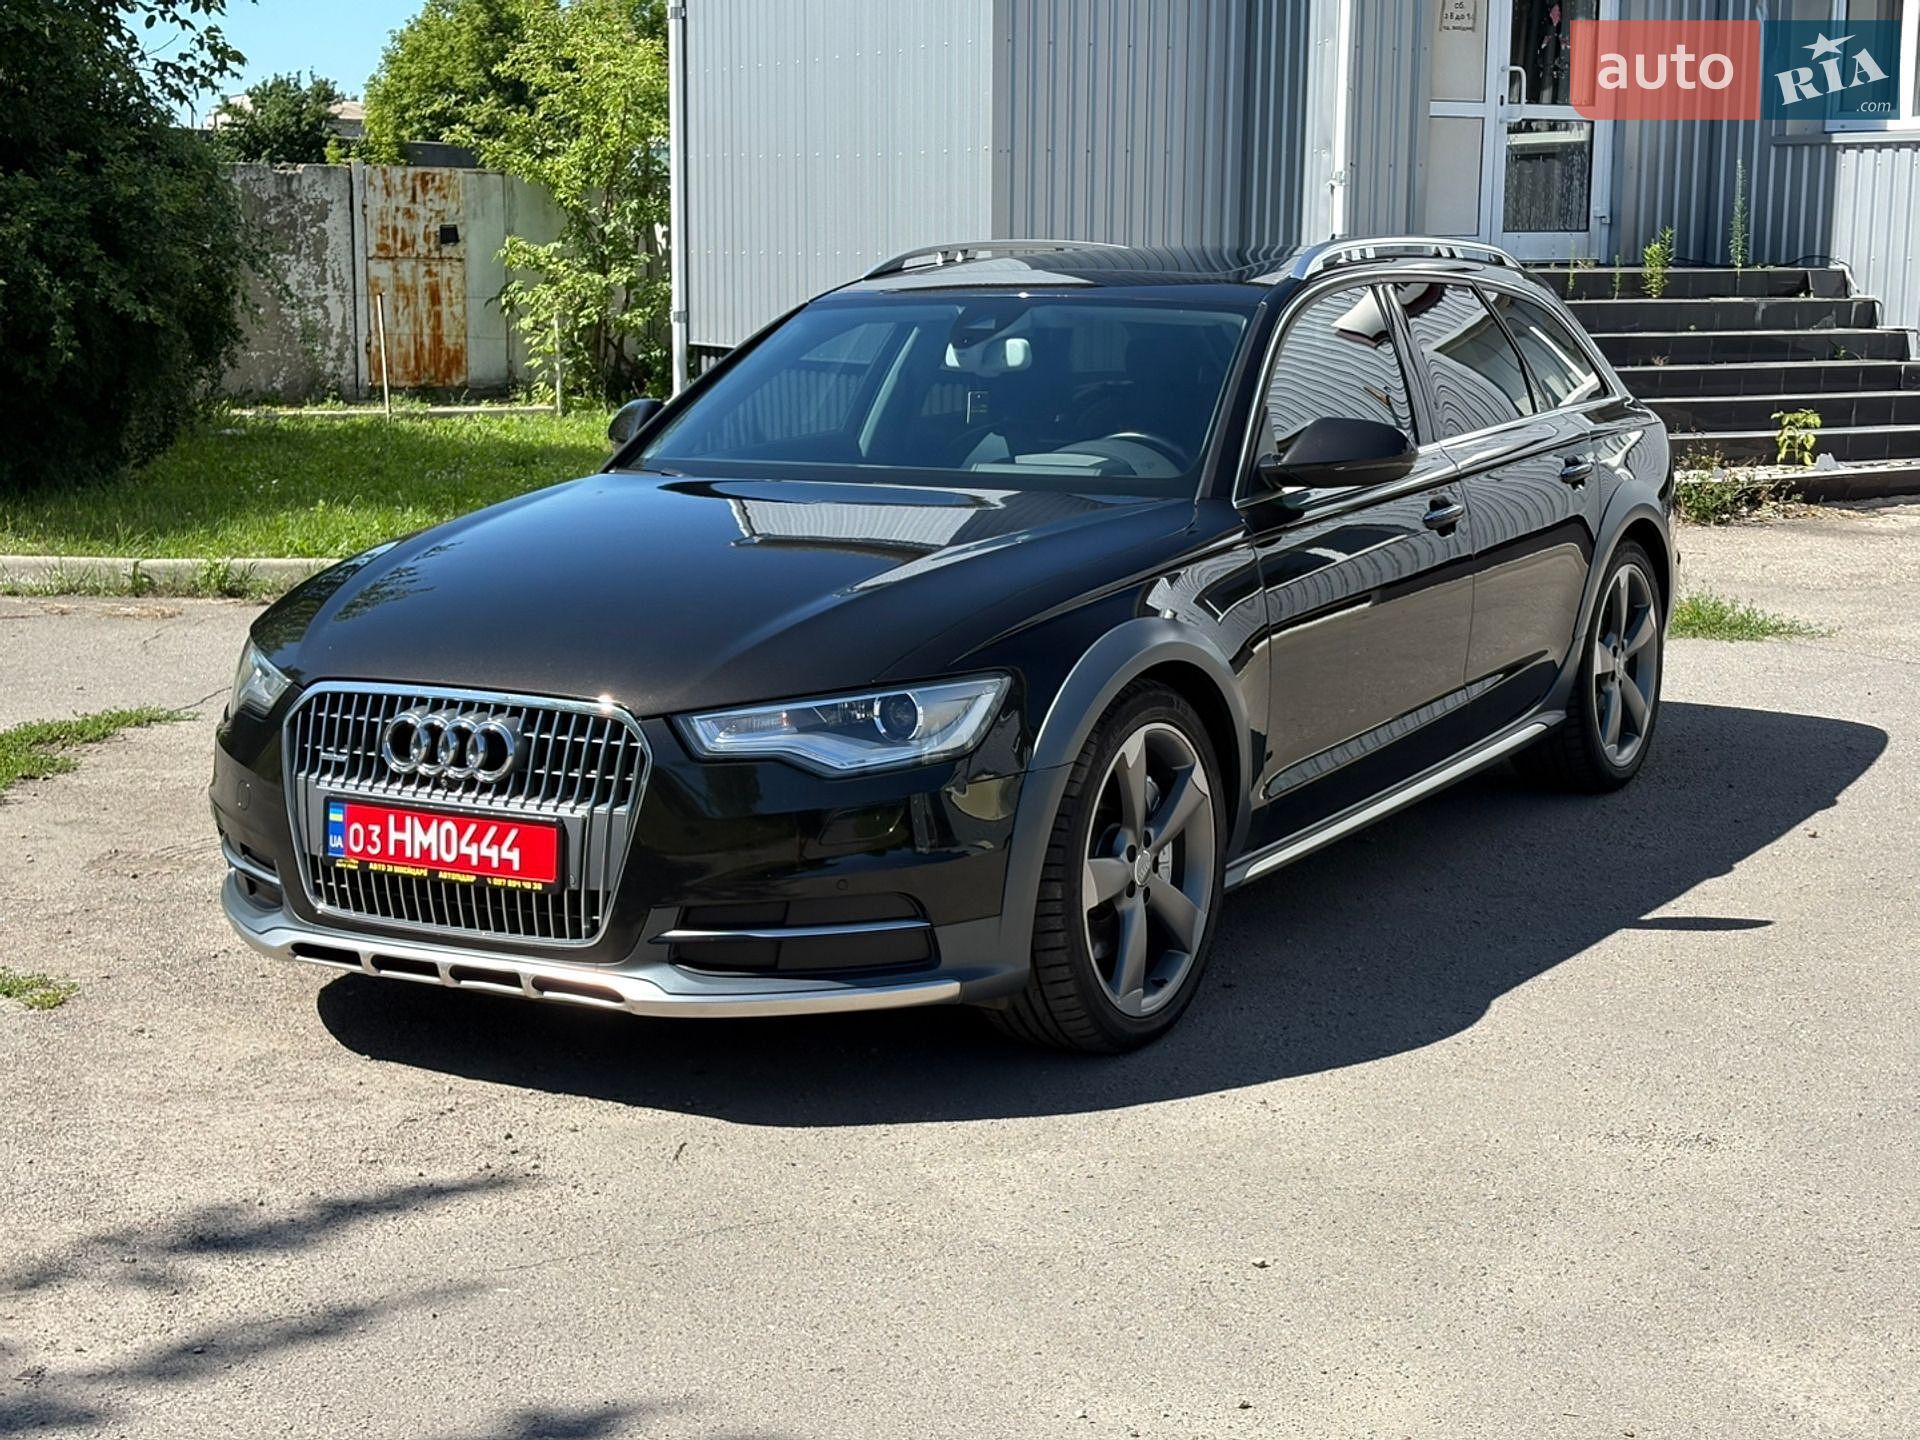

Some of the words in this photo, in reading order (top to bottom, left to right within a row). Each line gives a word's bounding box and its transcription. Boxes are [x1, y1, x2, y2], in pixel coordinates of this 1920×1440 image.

[329, 834, 344, 848] UA
[348, 822, 382, 855] 03
[387, 813, 521, 871] HM0444
